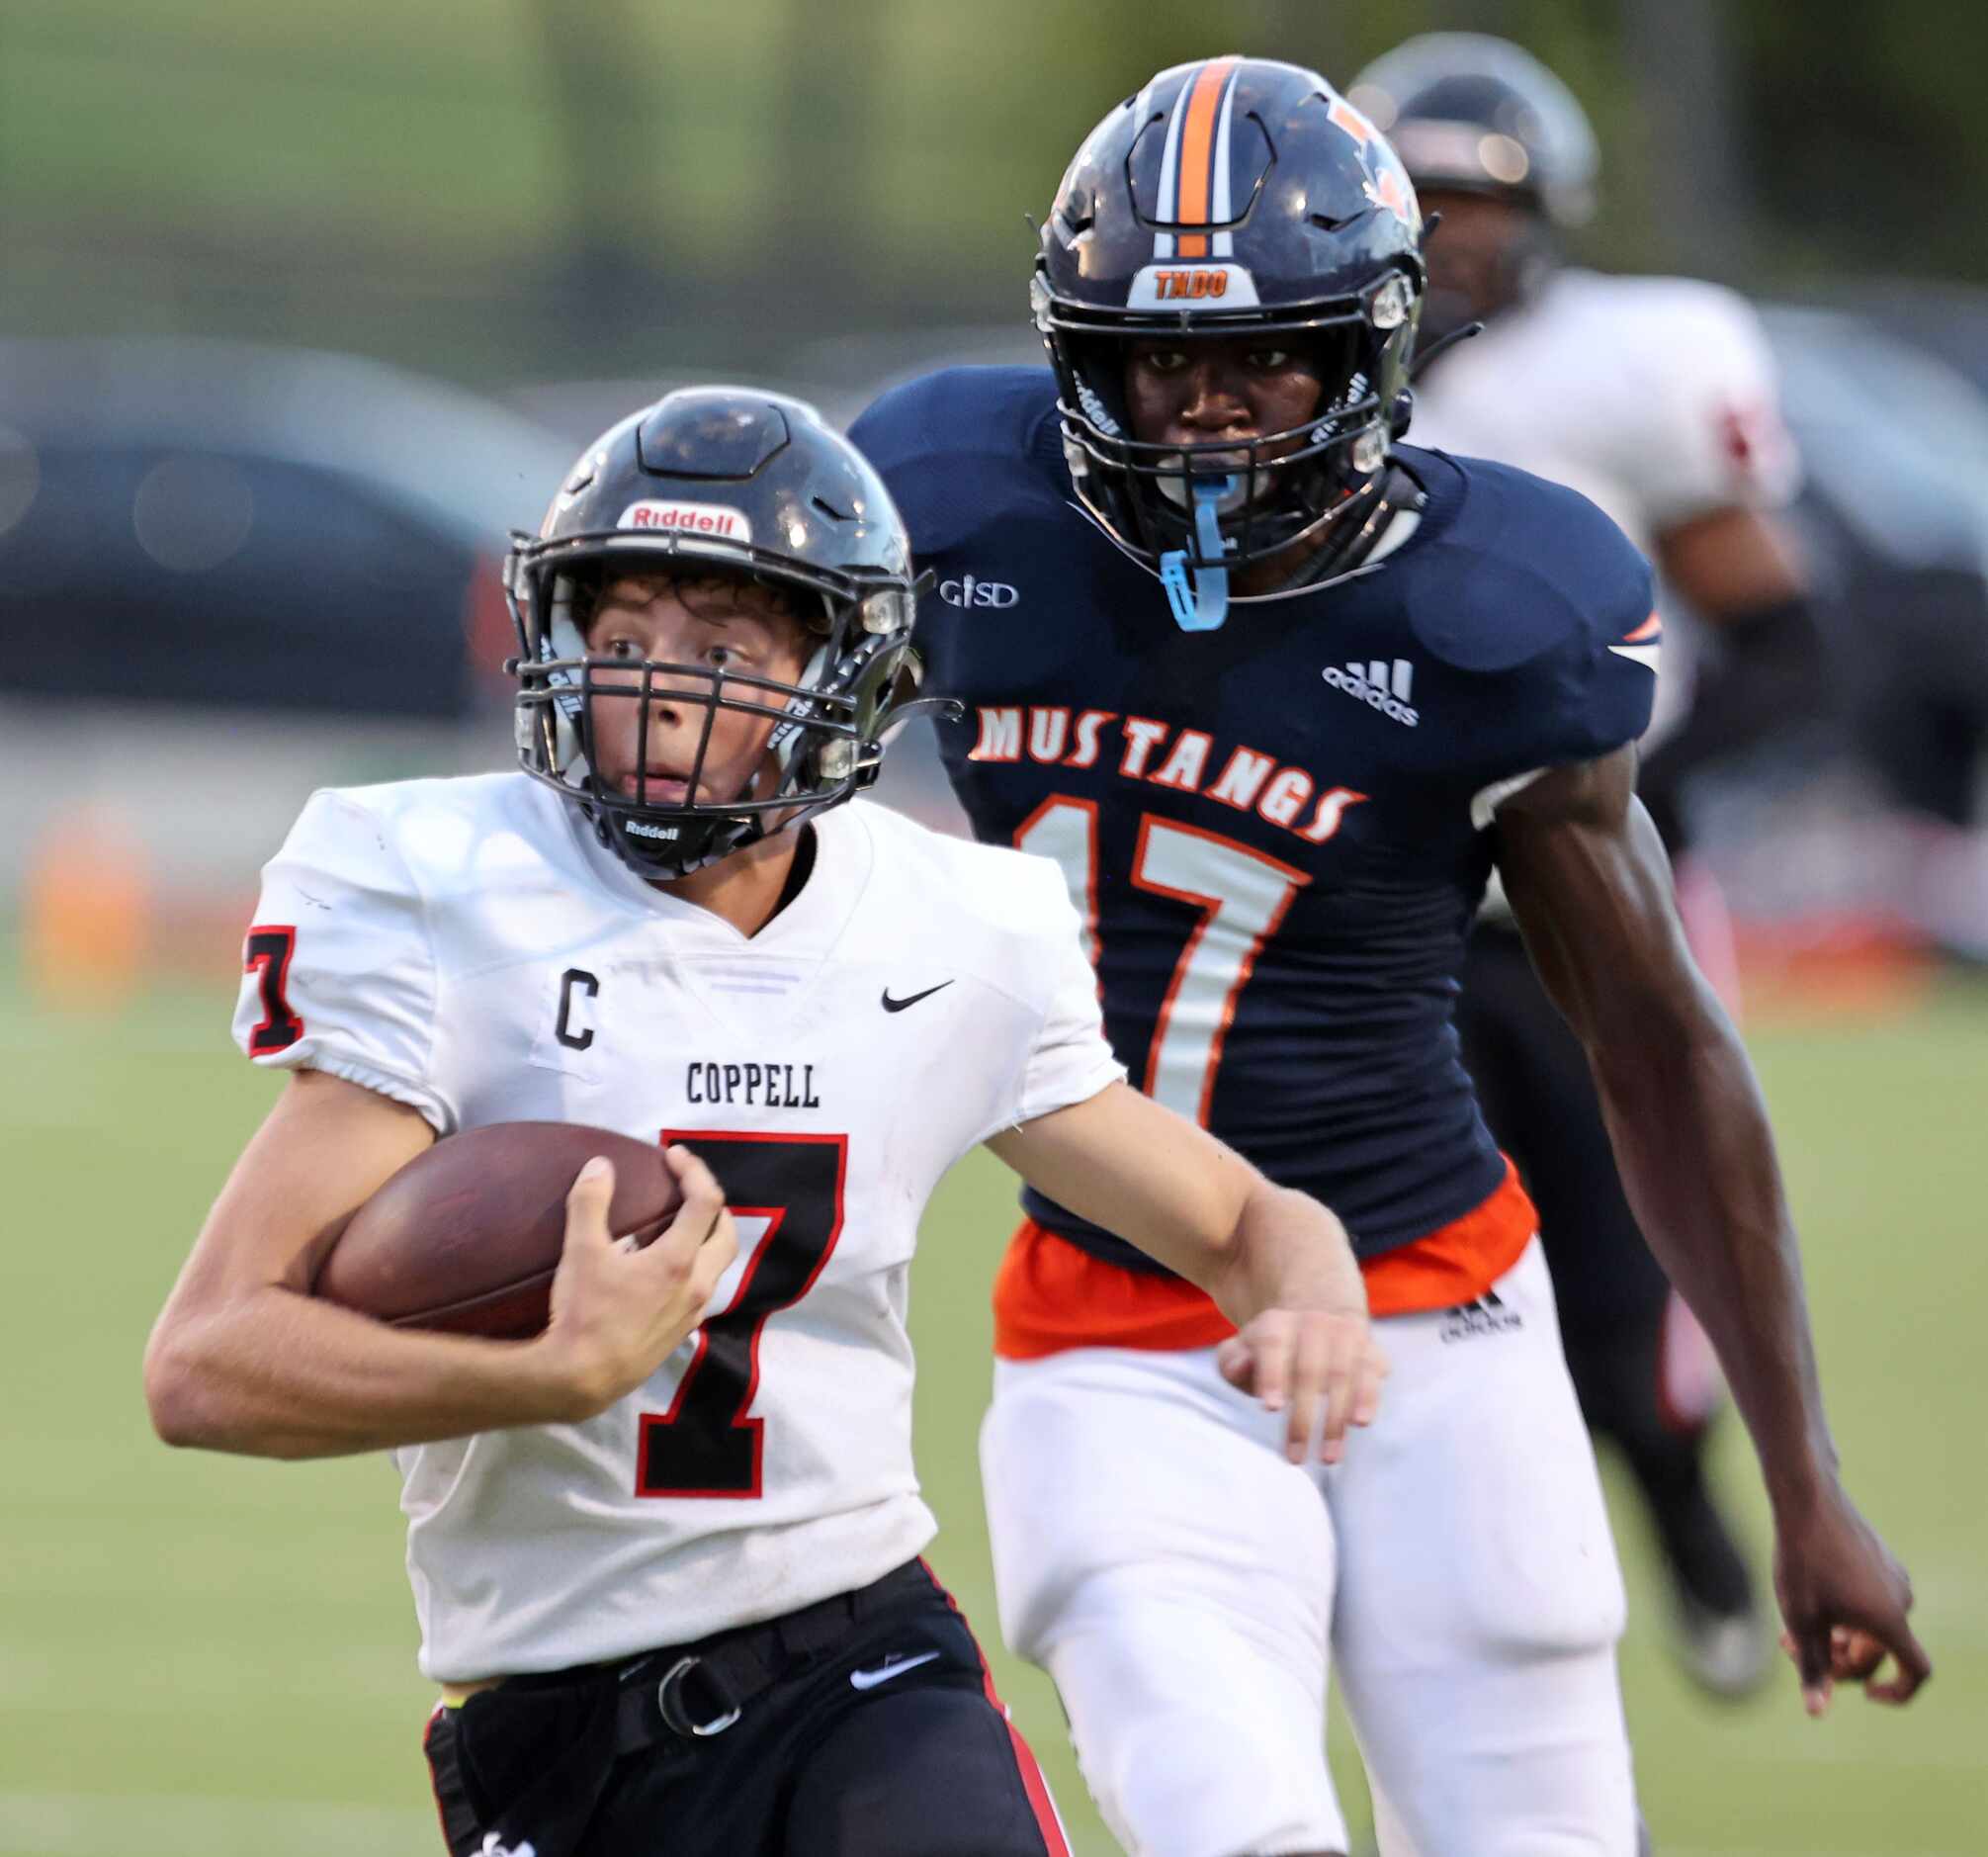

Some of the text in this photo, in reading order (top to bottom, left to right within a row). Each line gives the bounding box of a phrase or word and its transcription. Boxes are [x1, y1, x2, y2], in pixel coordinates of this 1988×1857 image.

[633, 507, 734, 534] Riddell
[1322, 666, 1420, 727] adidas
[968, 706, 1369, 844] MUSTANGS
[626, 820, 679, 840] Riddell
[244, 925, 305, 1060] 7
[556, 968, 599, 1051] C
[686, 1062, 820, 1108] COPPELL
[635, 1129, 849, 1499] 7
